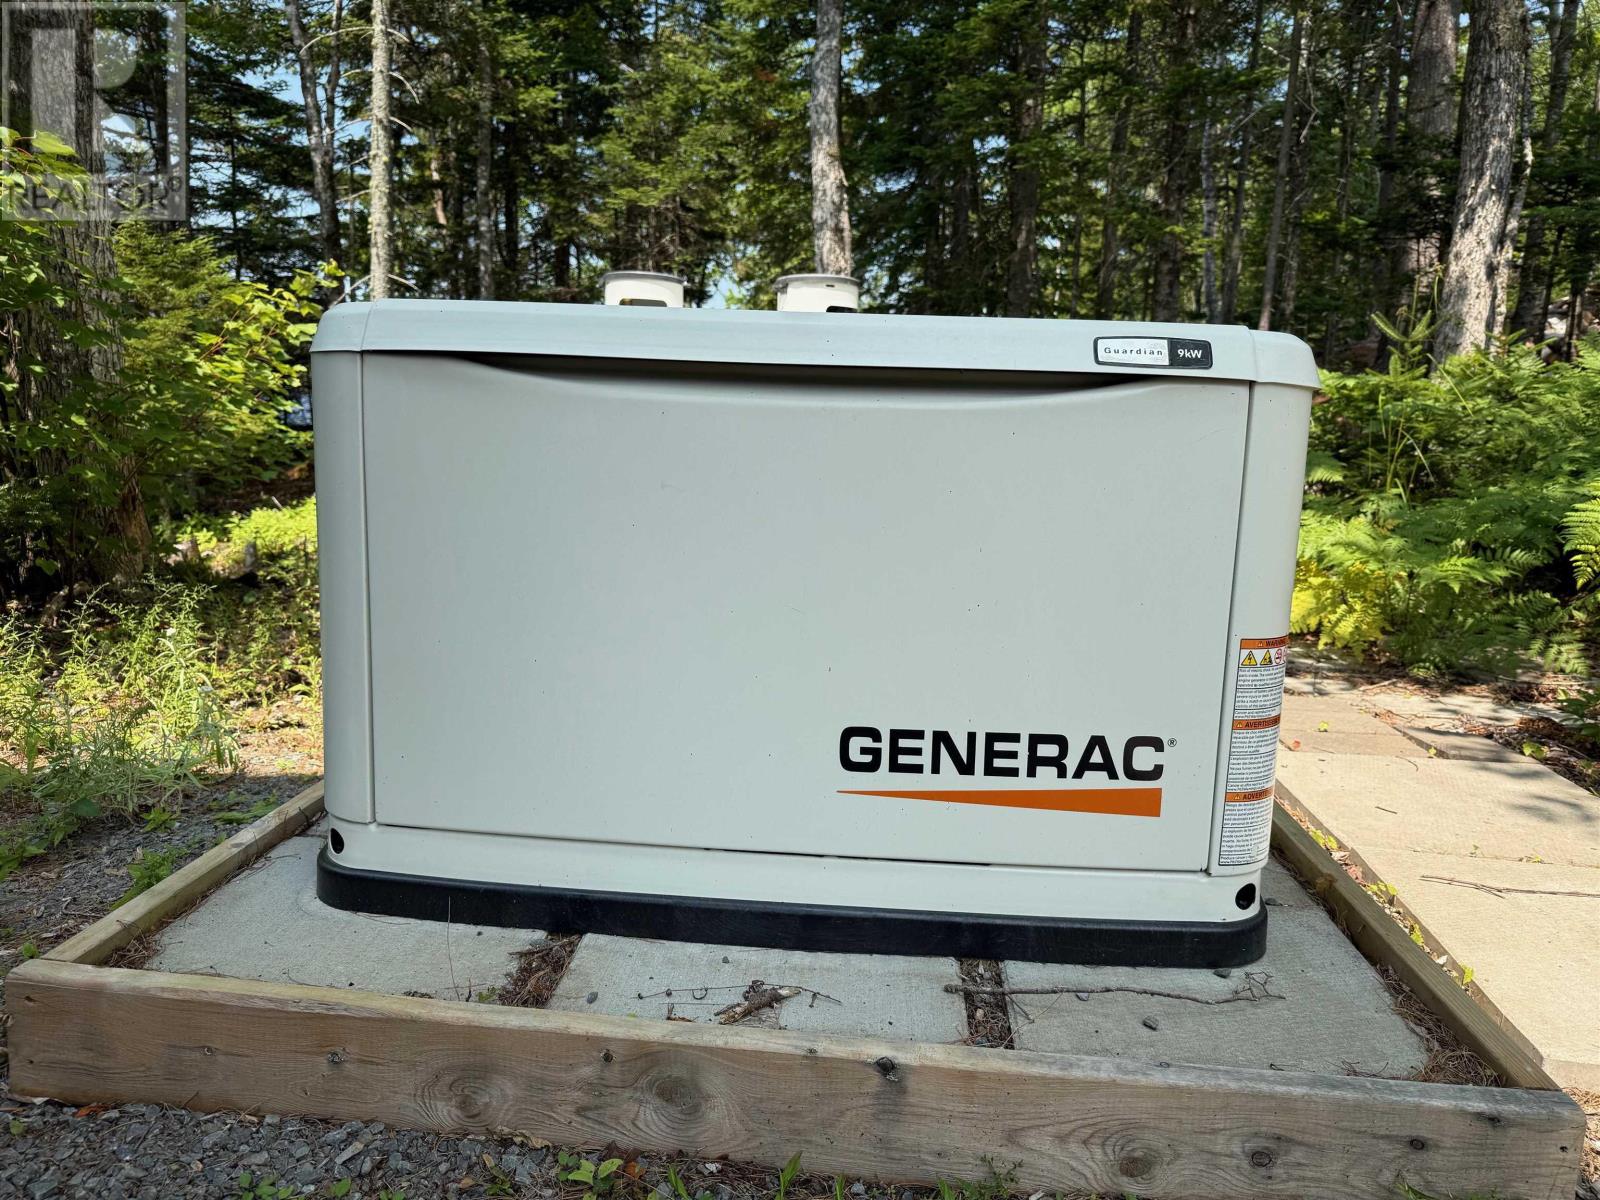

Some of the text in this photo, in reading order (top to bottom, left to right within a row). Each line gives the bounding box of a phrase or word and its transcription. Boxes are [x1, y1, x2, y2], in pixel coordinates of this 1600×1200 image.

[1104, 347, 1203, 359] Guardian 9kW
[839, 726, 1165, 782] GENERAC
